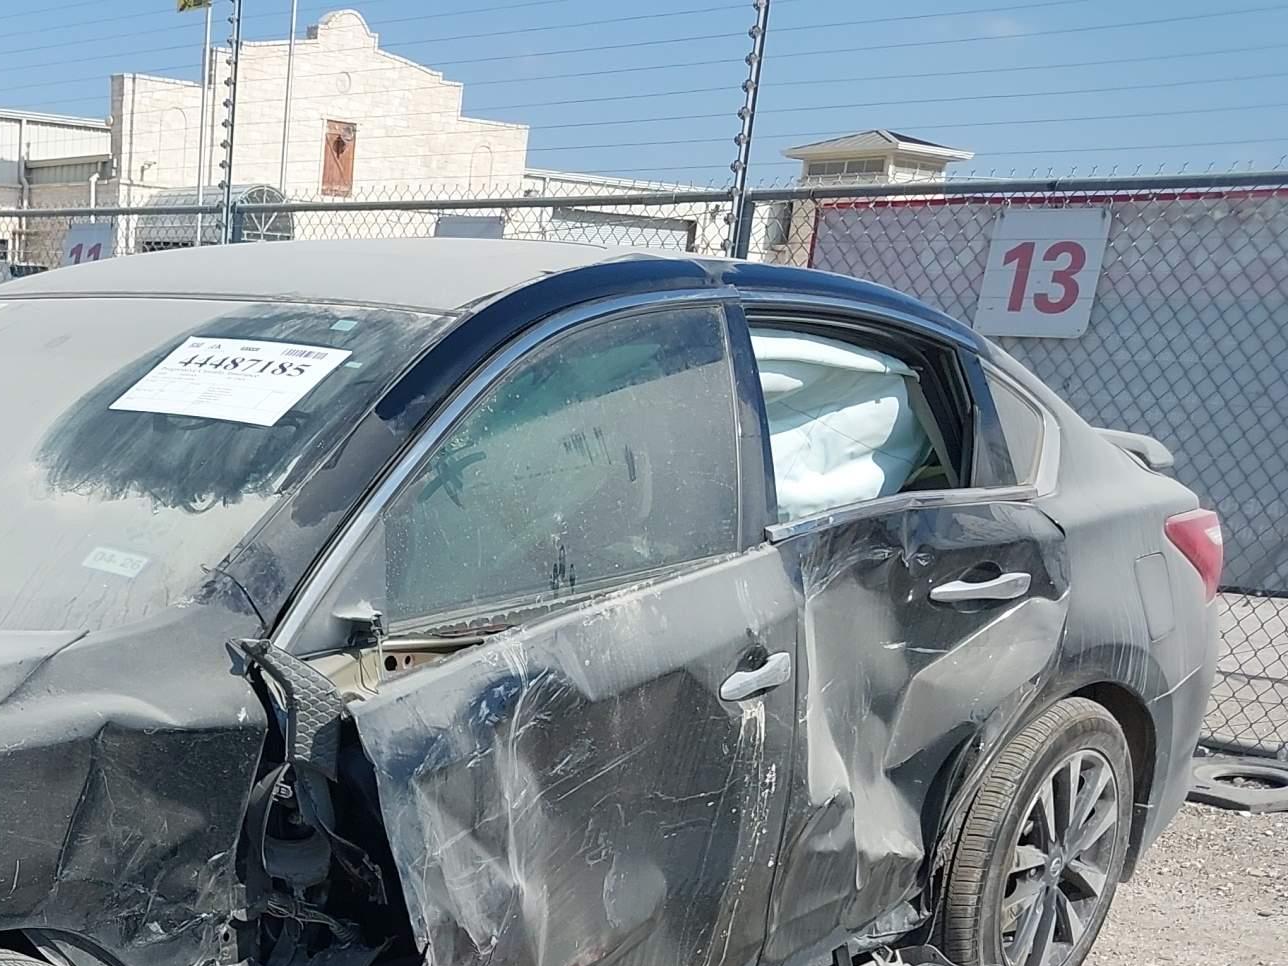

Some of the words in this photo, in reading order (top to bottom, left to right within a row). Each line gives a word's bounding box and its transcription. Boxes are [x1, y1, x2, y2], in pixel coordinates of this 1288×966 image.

[69, 243, 103, 264] 11
[1002, 240, 1087, 315] 13
[178, 354, 312, 377] 44487185
